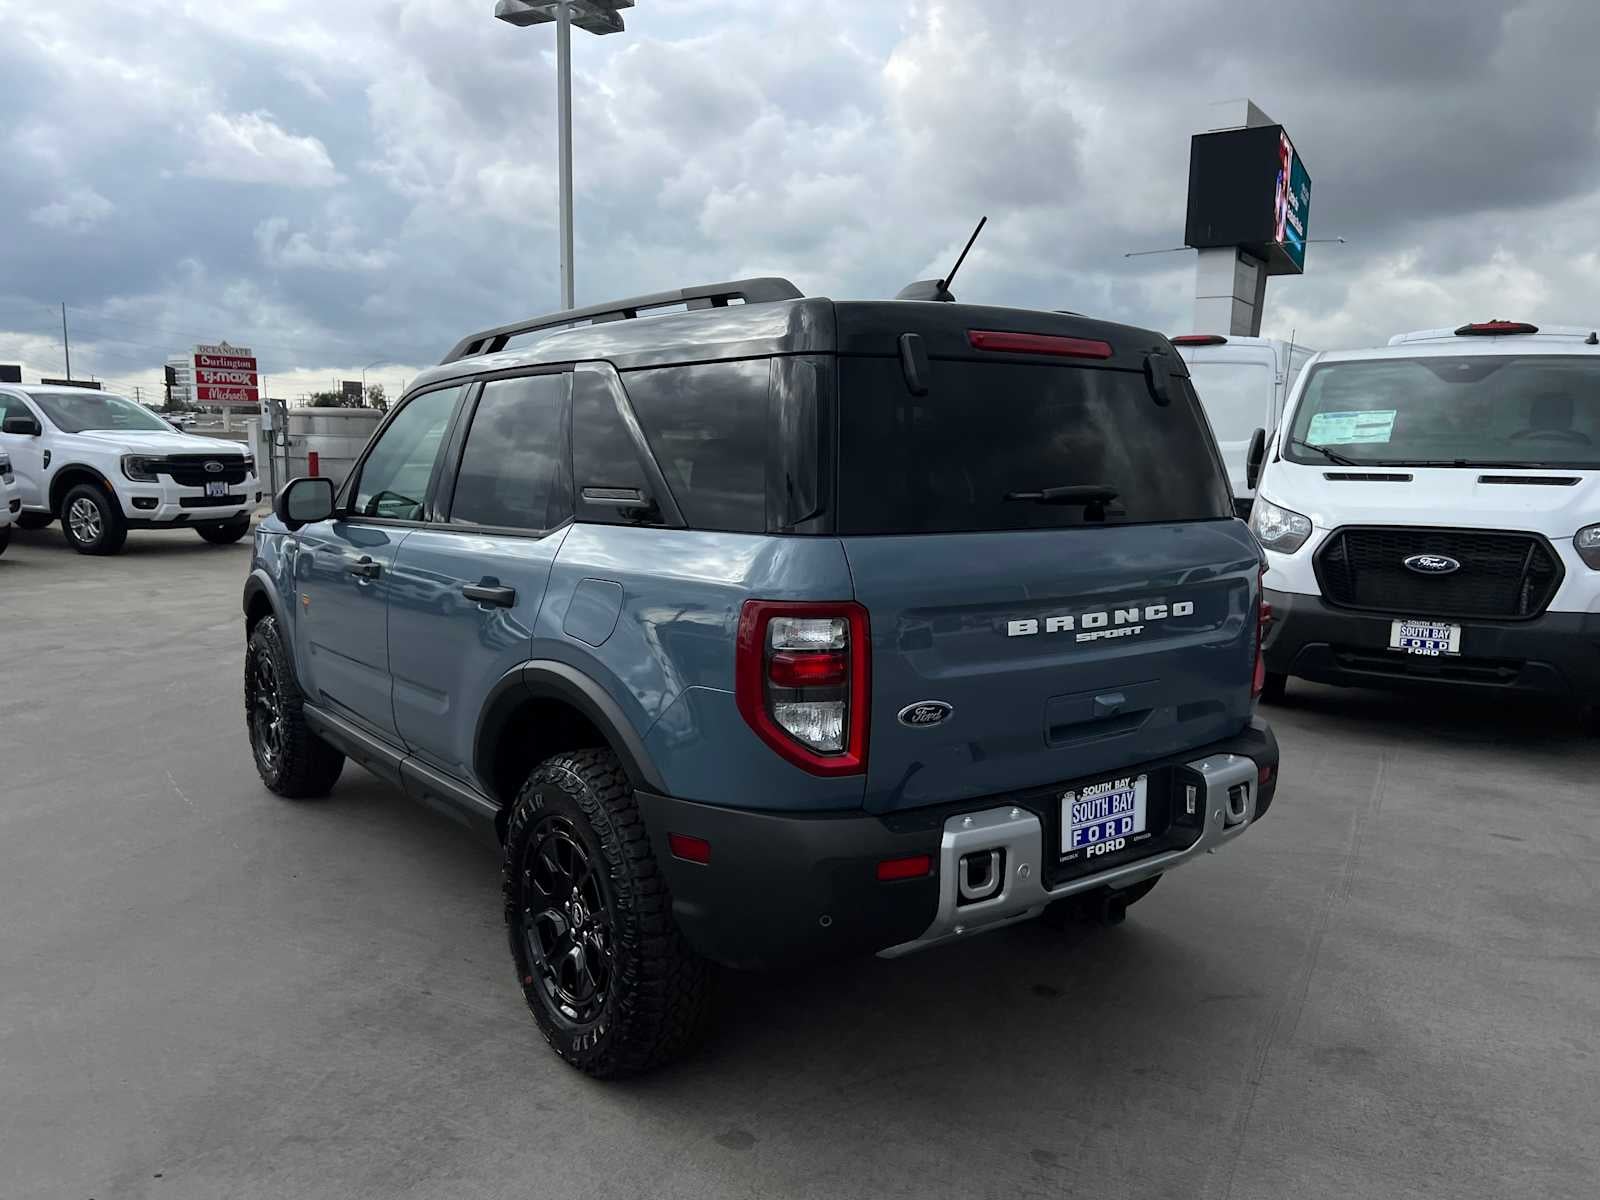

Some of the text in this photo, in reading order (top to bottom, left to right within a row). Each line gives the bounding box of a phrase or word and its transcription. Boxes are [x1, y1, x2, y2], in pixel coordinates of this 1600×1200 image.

[201, 356, 251, 369] Burlington
[208, 387, 248, 400] Michaels
[1418, 557, 1448, 568] Ford
[1007, 601, 1194, 637] BRONCO
[1075, 625, 1145, 642] SPORT
[1401, 626, 1450, 639] SOUTH BAY
[1401, 638, 1448, 649] FORD
[1407, 648, 1439, 656] FORD
[911, 706, 943, 722] Ford
[1083, 781, 1112, 797] SOUTH
[1114, 777, 1131, 789] BAY
[1072, 792, 1134, 823] SOUTH BAY
[1073, 817, 1132, 846] FORD
[1087, 838, 1126, 859] FORD
